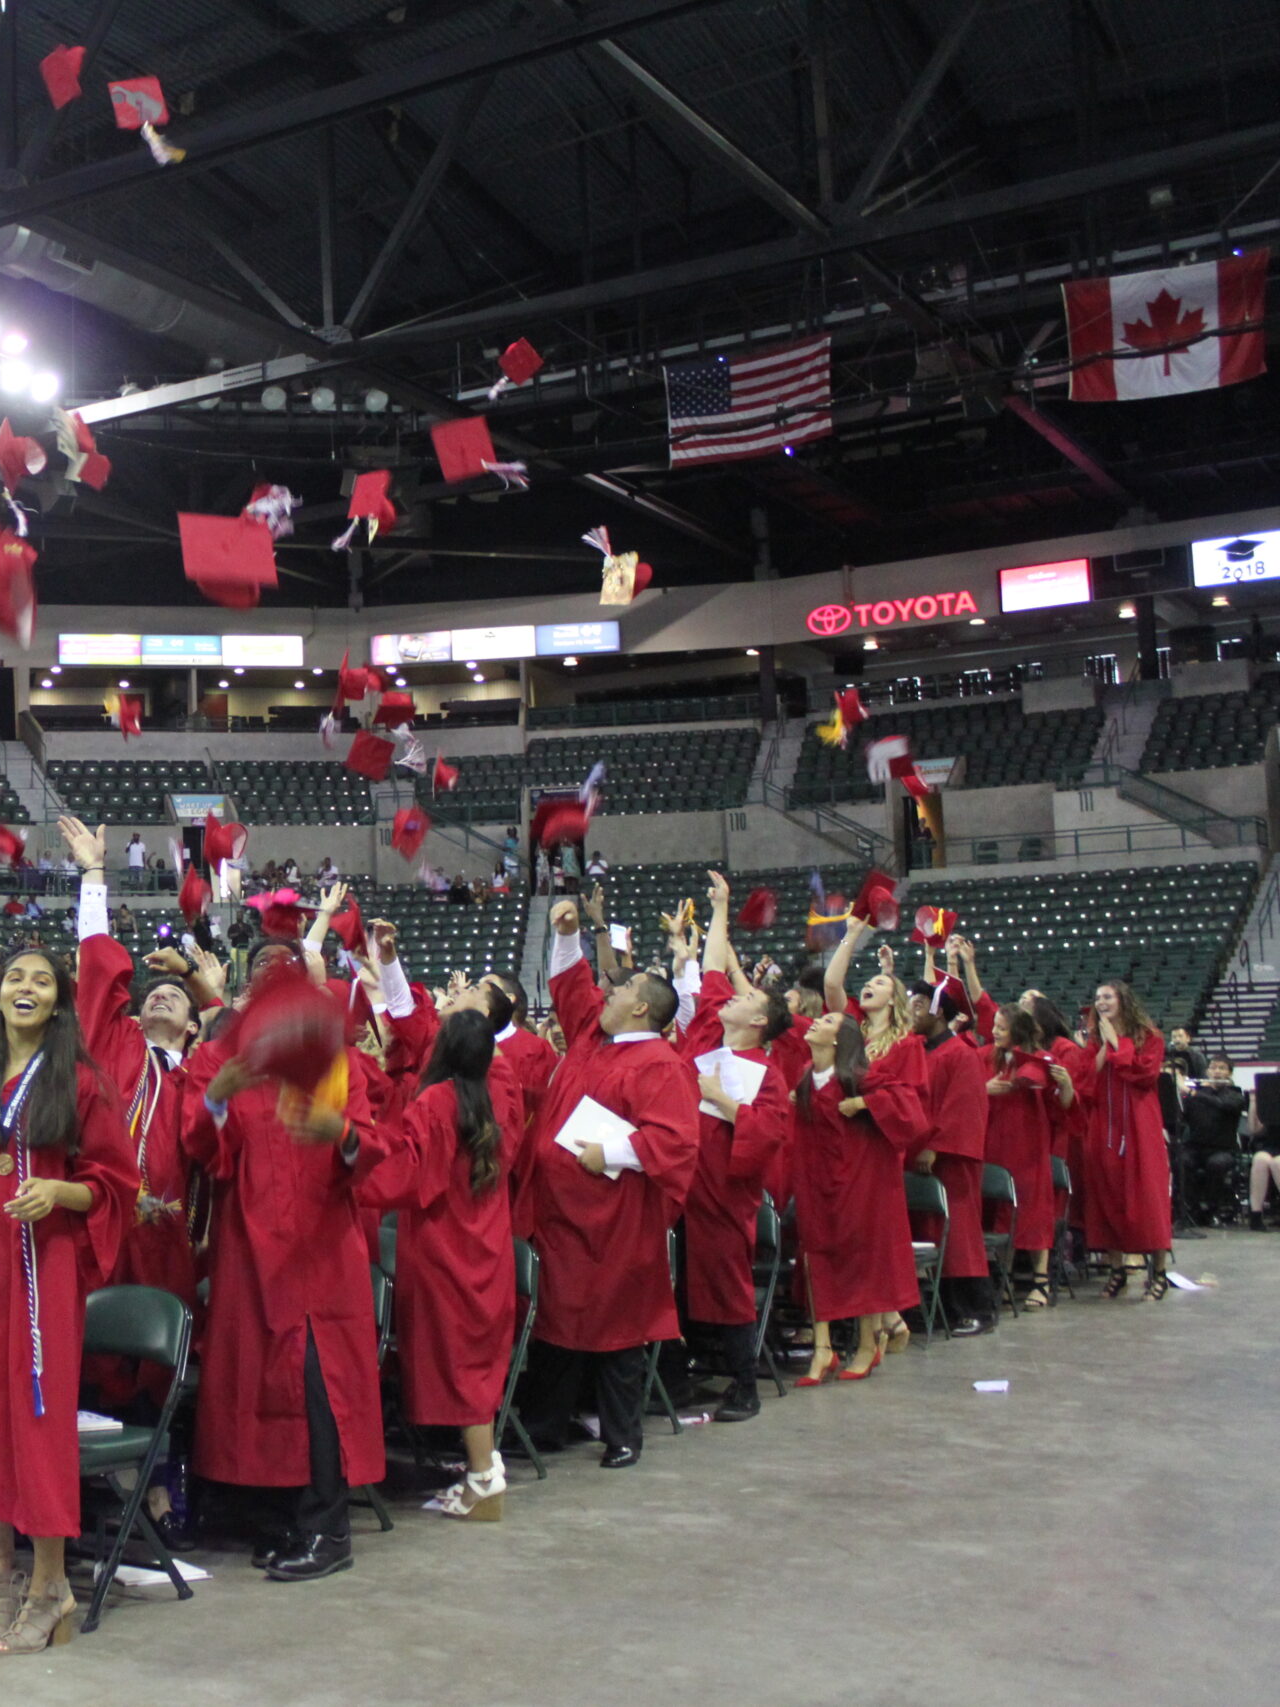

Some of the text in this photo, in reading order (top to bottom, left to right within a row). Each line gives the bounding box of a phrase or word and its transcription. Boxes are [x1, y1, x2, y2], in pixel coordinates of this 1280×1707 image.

[1222, 561, 1265, 580] 2018
[854, 590, 977, 627] TOYOTA
[1079, 791, 1094, 812] 111
[729, 812, 747, 832] 110
